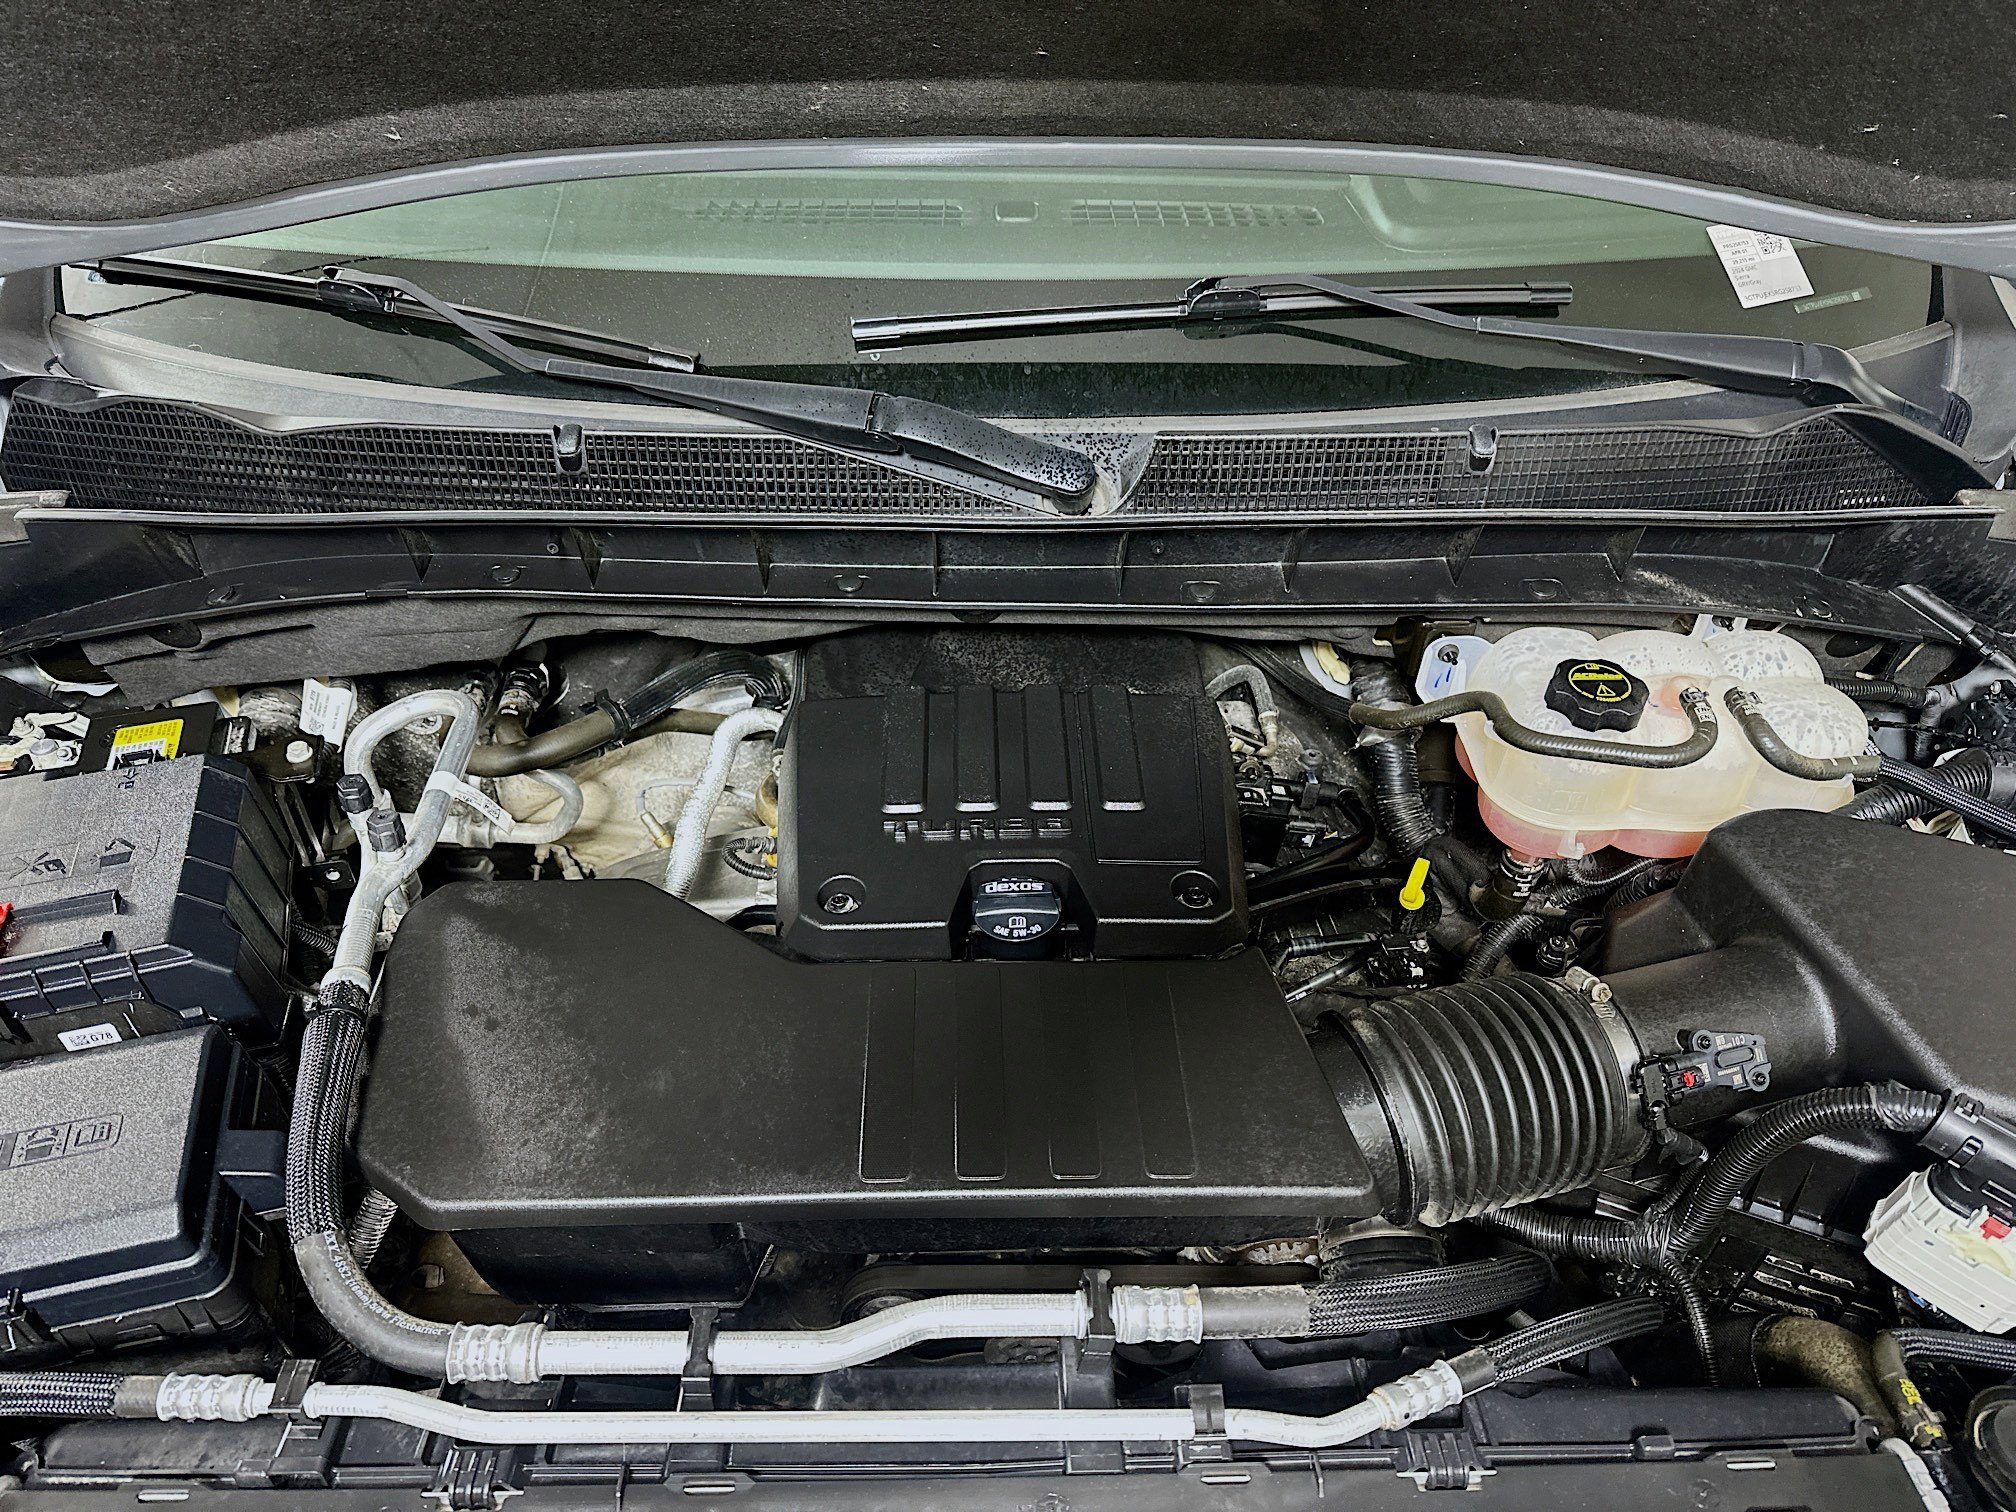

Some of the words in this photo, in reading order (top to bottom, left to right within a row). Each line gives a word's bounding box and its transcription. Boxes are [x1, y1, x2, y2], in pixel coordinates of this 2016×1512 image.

[882, 818, 1073, 843] TURBO
[985, 881, 1045, 893] dexos
[993, 925, 1010, 936] SAE
[1012, 924, 1042, 938] 5W-30
[390, 1316, 444, 1336] Flexbarrier
